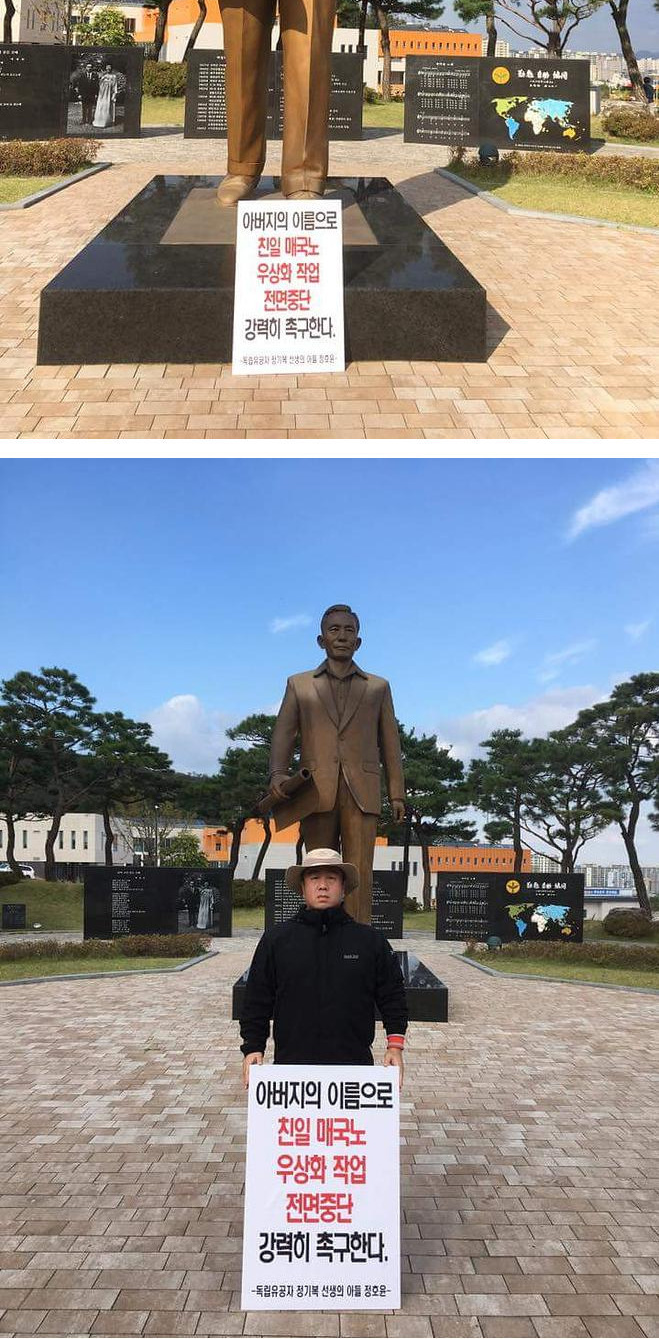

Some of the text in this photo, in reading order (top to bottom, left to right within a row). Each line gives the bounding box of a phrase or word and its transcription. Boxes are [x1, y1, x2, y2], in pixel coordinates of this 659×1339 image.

[243, 211, 338, 231] 아버지의 이름으로
[258, 236, 319, 257] 친일 매국노
[257, 263, 319, 284] 우상화 작업
[264, 289, 311, 312] 전면중단
[245, 316, 336, 341] 강력히 촉구한다.
[256, 1081, 394, 1110] 아버지의 이름으로
[278, 1117, 367, 1146] 친일 매국노
[276, 1154, 367, 1185] 우상화 작업
[286, 1193, 353, 1223] 전면중단
[259, 1231, 388, 1263] 강력히 촉구한다.
[297, 1285, 319, 1297] 정기복
[321, 1285, 344, 1297] 선생의
[346, 1285, 361, 1297] 아들
